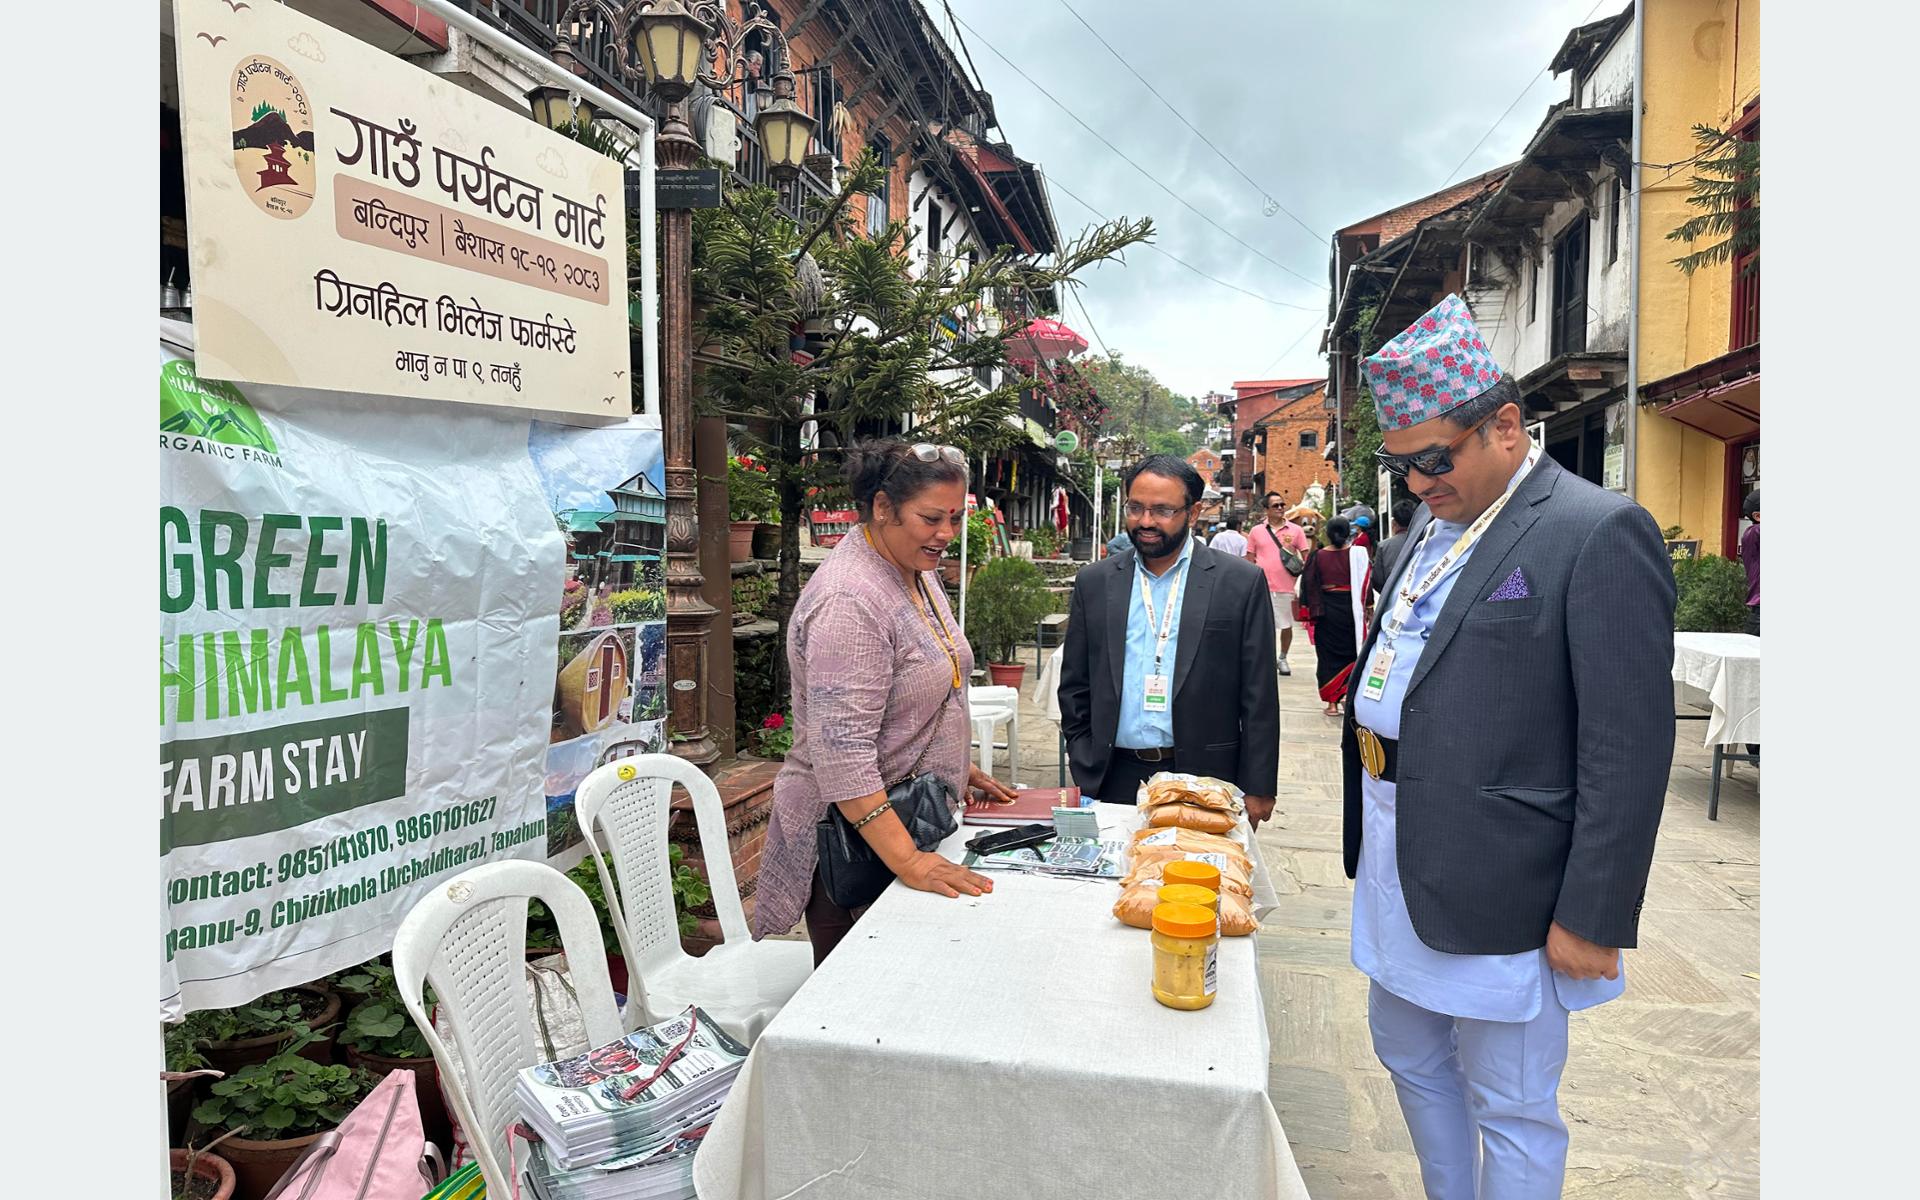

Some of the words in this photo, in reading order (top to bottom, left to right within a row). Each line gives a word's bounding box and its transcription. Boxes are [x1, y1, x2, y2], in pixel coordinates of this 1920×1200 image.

[329, 107, 423, 188] गाउँ
[432, 146, 544, 230] पर्यटन
[552, 193, 607, 250] मार्ट
[352, 198, 430, 249] बन्दिपुर
[453, 218, 506, 265] बैशाख
[563, 263, 601, 293] २०८३
[313, 268, 429, 329] ग्रिनहिल
[436, 294, 504, 342] भिलेज
[509, 312, 577, 354] फार्मस्टे
[395, 350, 430, 382] भानु
[433, 356, 448, 377] न
[452, 358, 467, 379] पा
[489, 362, 522, 392] तनहुँ
[242, 448, 283, 468] FARM
[160, 506, 388, 613] GREEN
[160, 618, 452, 726] HIMALAYA
[160, 747, 274, 820] FARM
[282, 730, 367, 795] STAY
[270, 876, 377, 929] Chitikhola
[491, 819, 545, 853] Tanahun
[277, 825, 394, 883] 9851141870,
[395, 796, 497, 846] 9860101627
